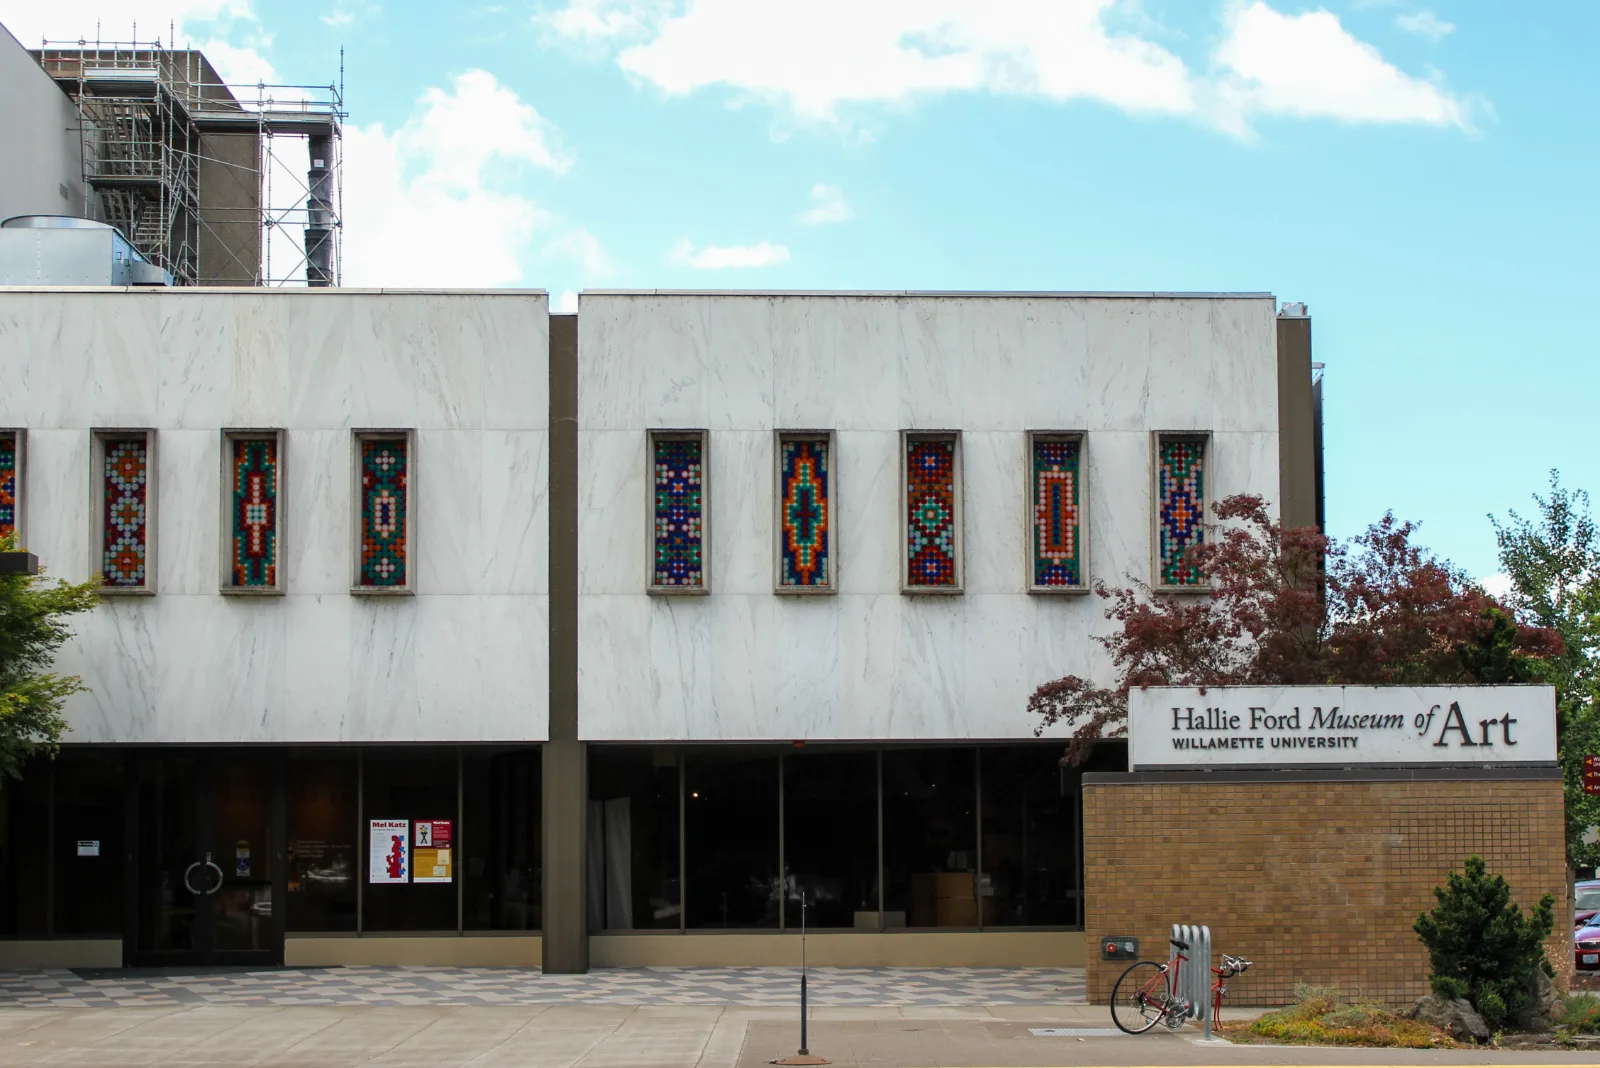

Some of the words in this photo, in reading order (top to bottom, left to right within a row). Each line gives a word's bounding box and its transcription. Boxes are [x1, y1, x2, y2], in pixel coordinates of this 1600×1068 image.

[1172, 707, 1241, 730] Hallie
[1249, 706, 1302, 730] Ford
[1308, 706, 1404, 730] Museum
[1414, 704, 1441, 737] of
[1433, 701, 1518, 748] Art
[1172, 737, 1265, 750] WILLAMETTE
[1271, 736, 1359, 749] UNIVERSITY
